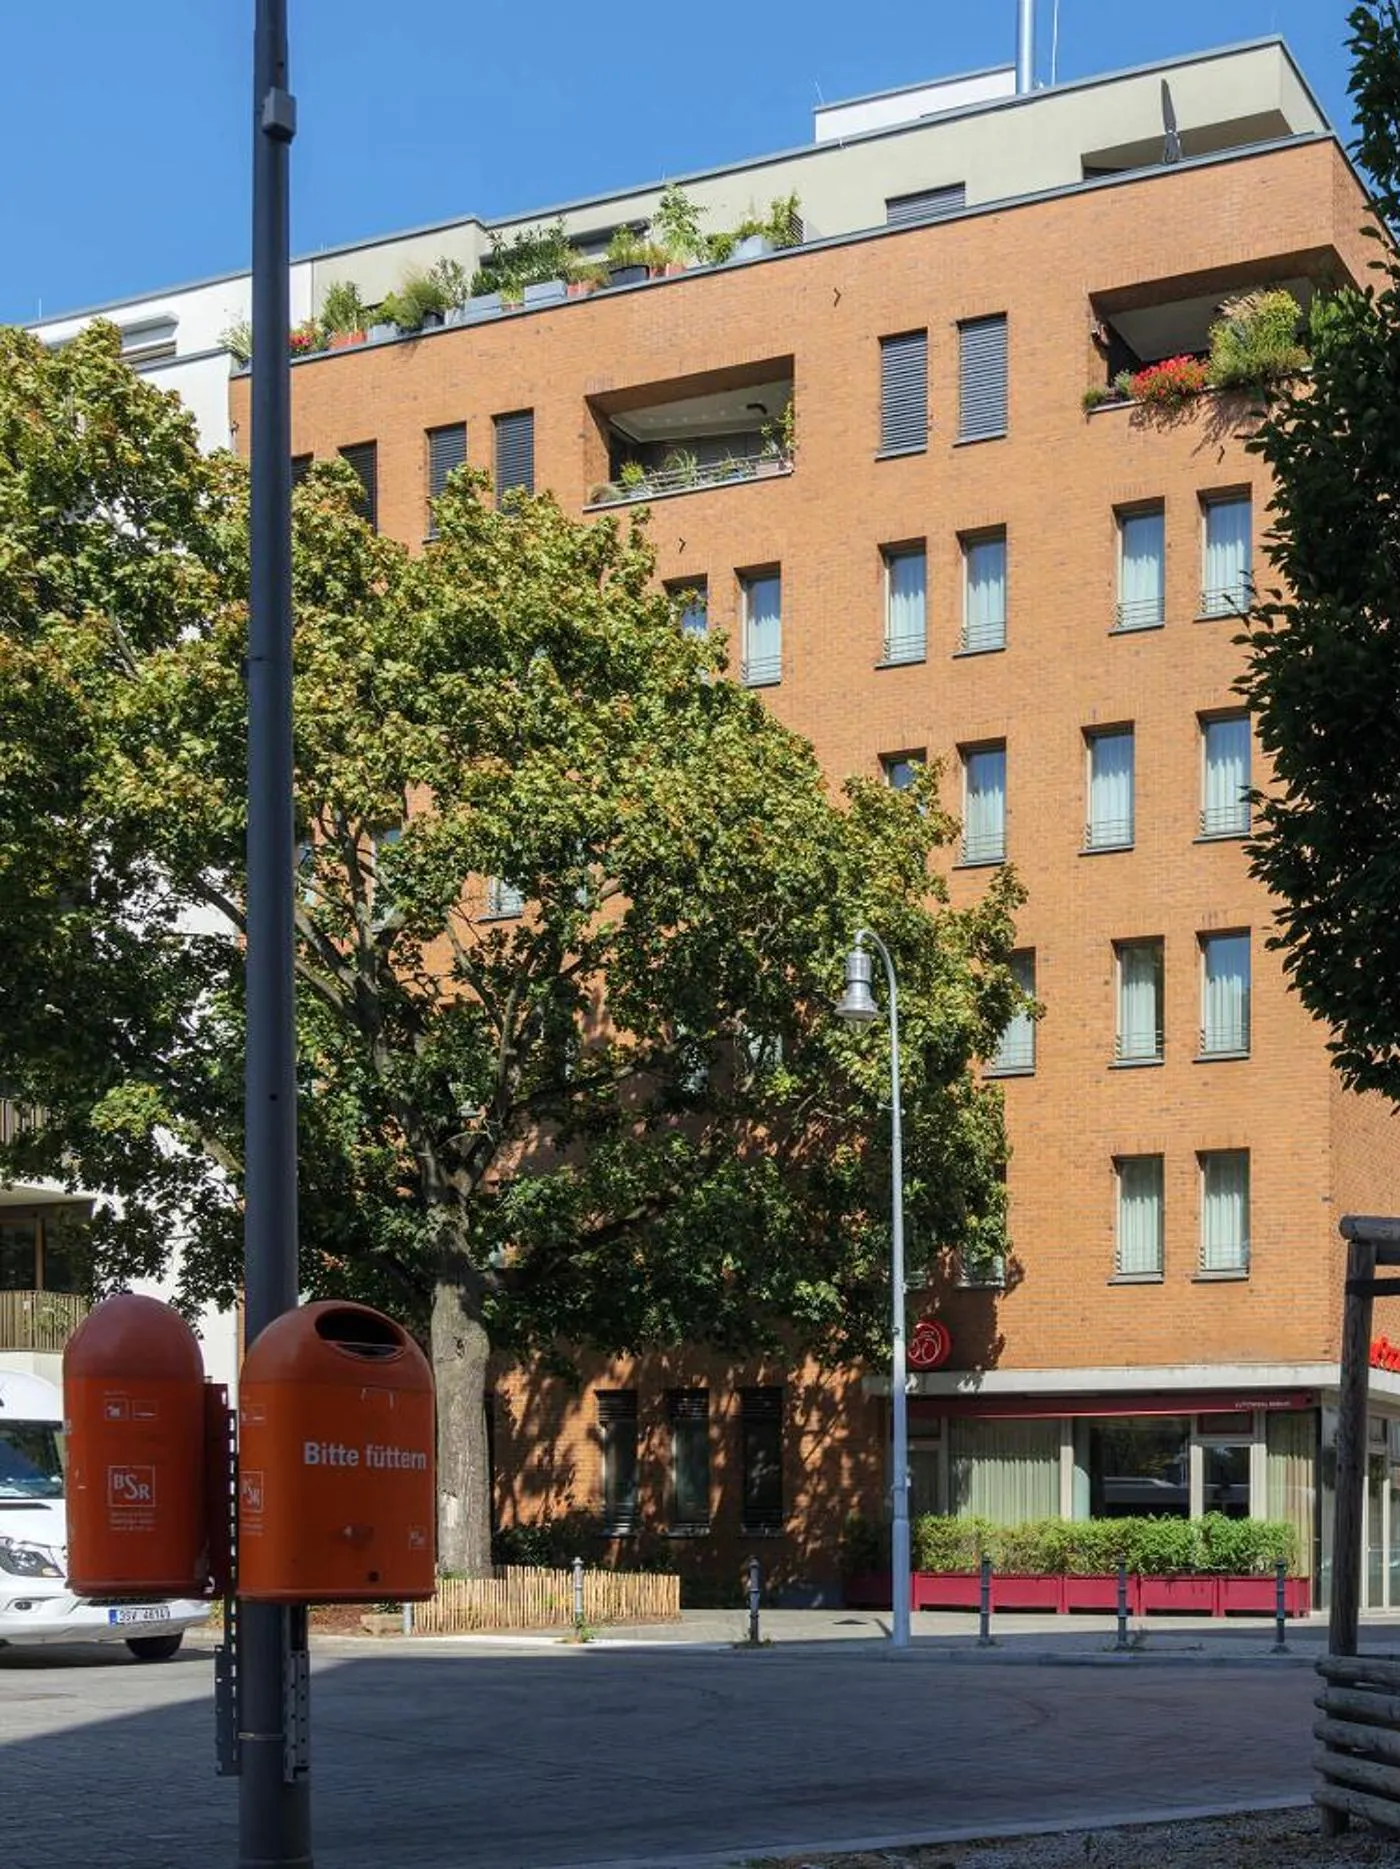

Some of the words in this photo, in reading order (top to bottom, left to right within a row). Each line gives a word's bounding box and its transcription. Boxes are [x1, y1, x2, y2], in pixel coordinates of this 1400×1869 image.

[304, 1441, 360, 1466] Bitte
[366, 1444, 427, 1469] füttern
[113, 1473, 151, 1500] BSR
